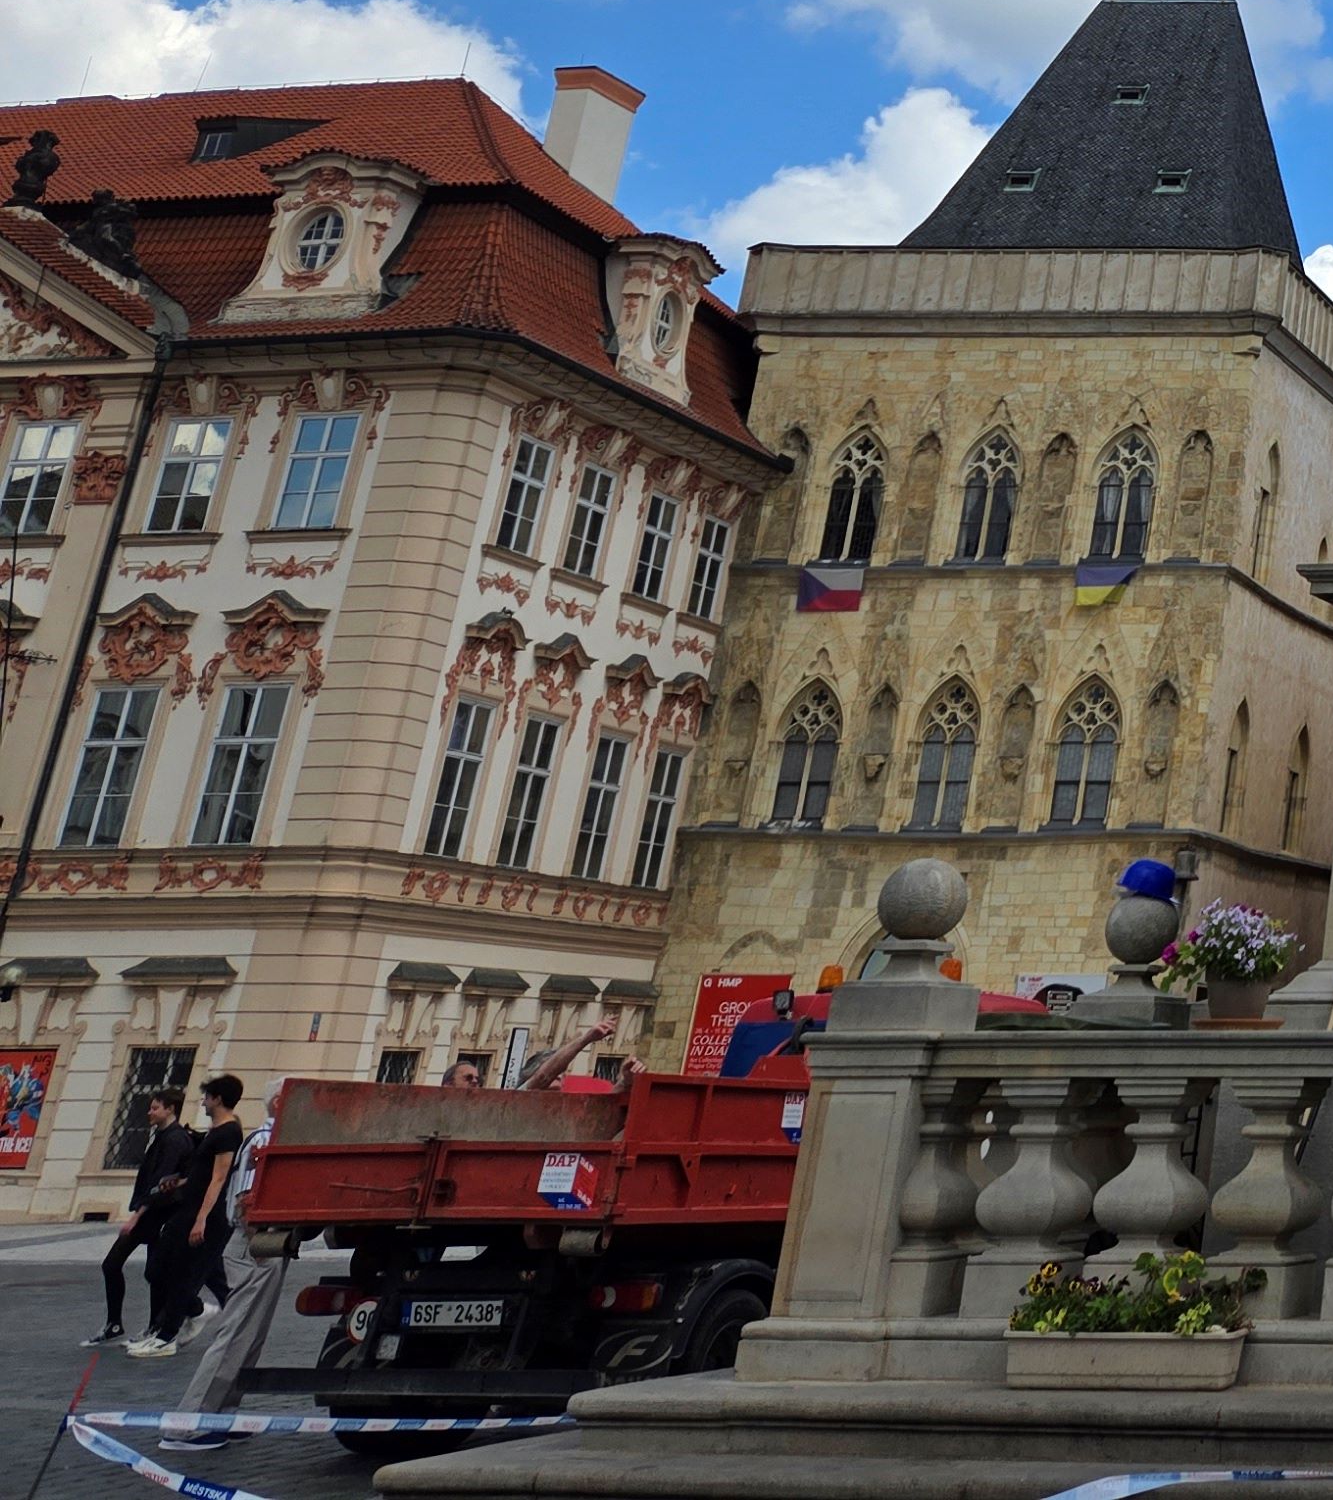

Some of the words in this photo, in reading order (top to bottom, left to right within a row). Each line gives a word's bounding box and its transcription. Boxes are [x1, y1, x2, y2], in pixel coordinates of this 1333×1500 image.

[717, 977, 743, 988] HMP
[690, 1046, 704, 1056] IN
[545, 1154, 577, 1167] DAP
[413, 1304, 443, 1324] 6SF
[454, 1303, 496, 1324] 2438
